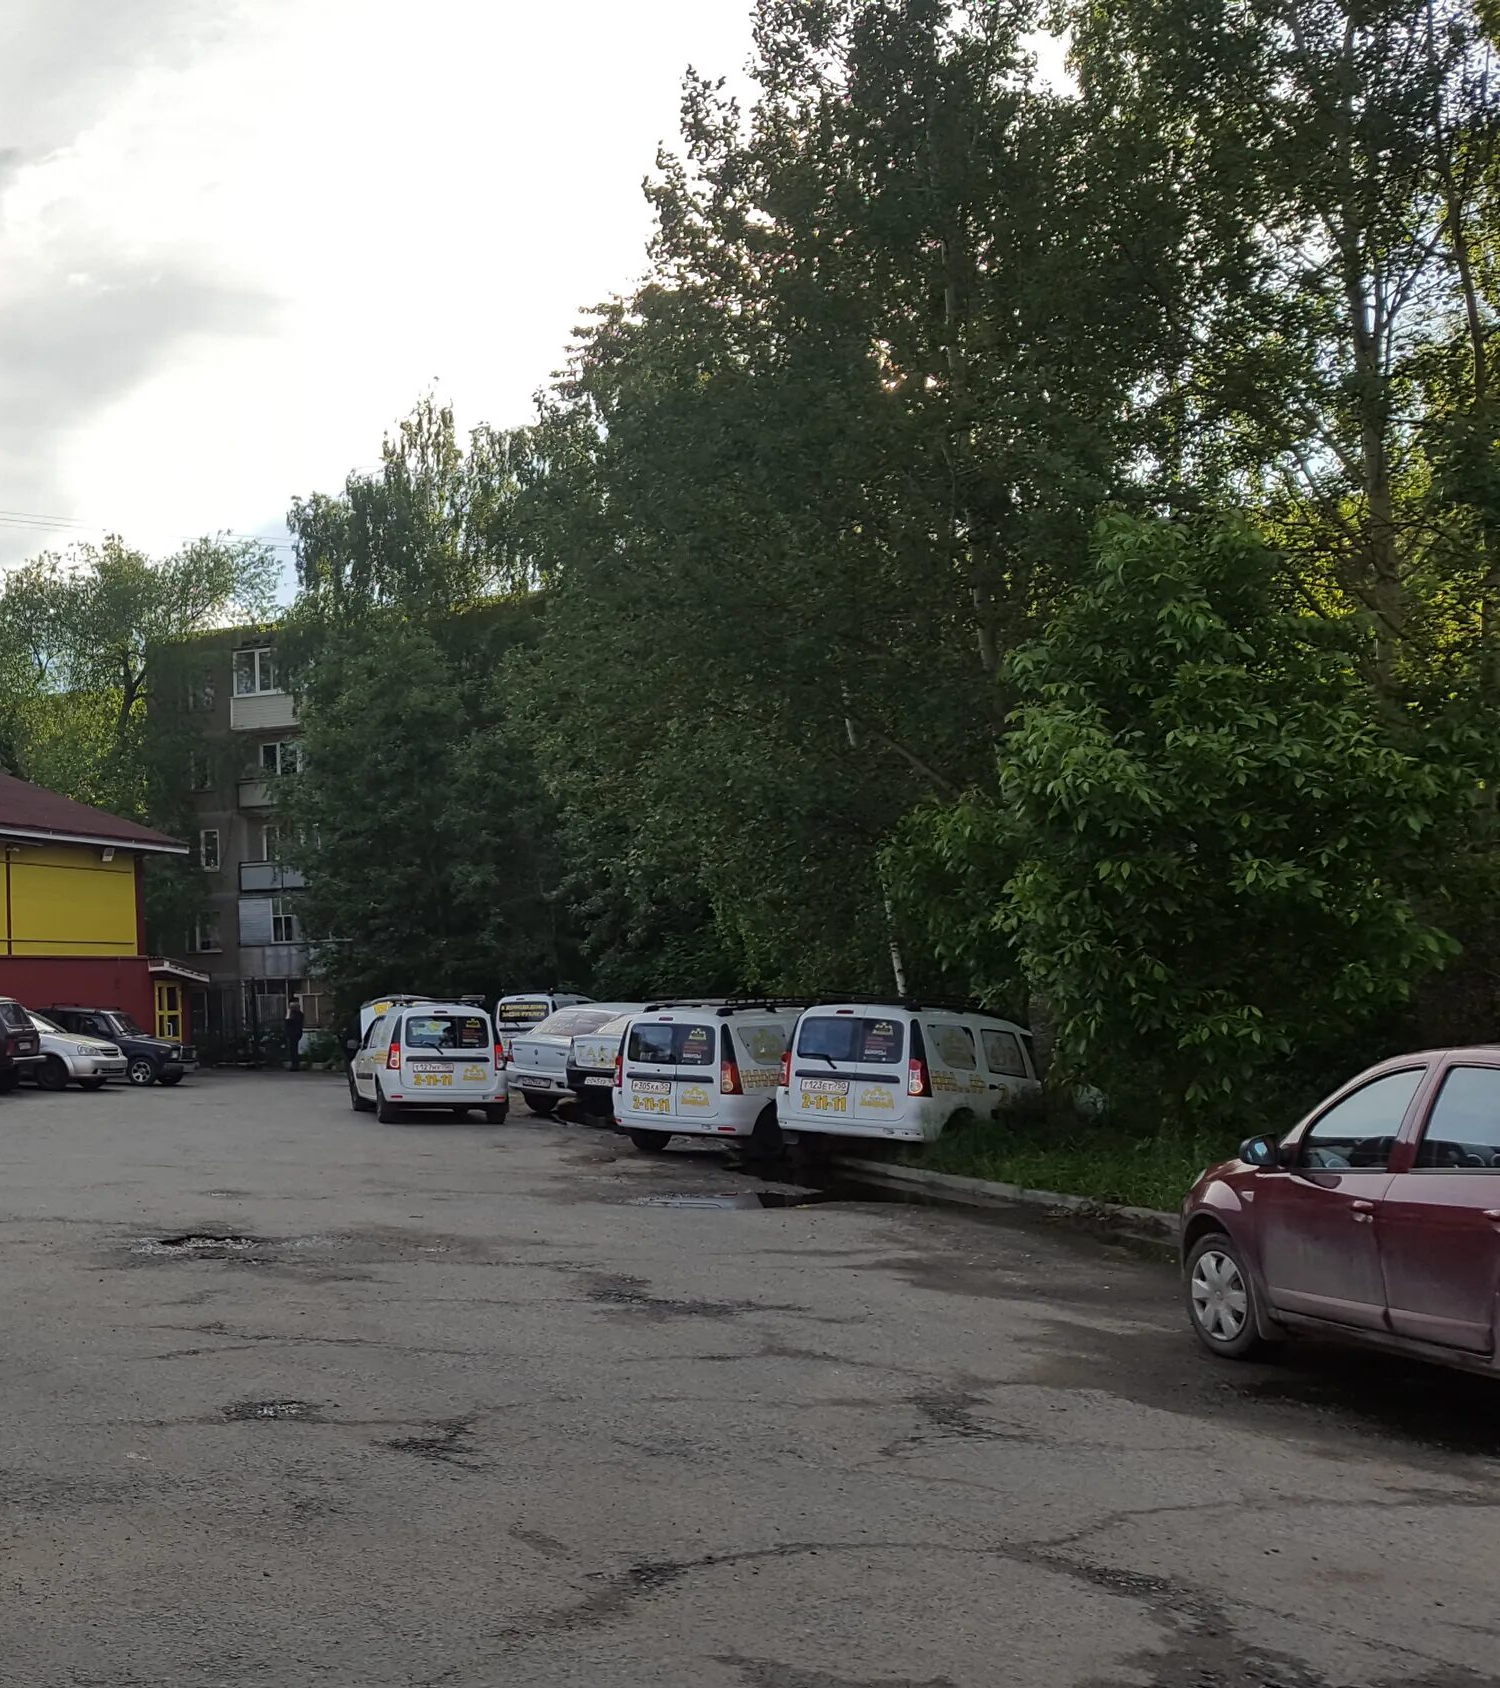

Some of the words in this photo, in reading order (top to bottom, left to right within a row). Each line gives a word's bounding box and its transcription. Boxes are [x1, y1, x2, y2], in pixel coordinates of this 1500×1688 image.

[414, 1074, 453, 1086] 2-11-11
[632, 1095, 671, 1112] 2-11-11
[802, 1094, 847, 1112] 2-11-11
